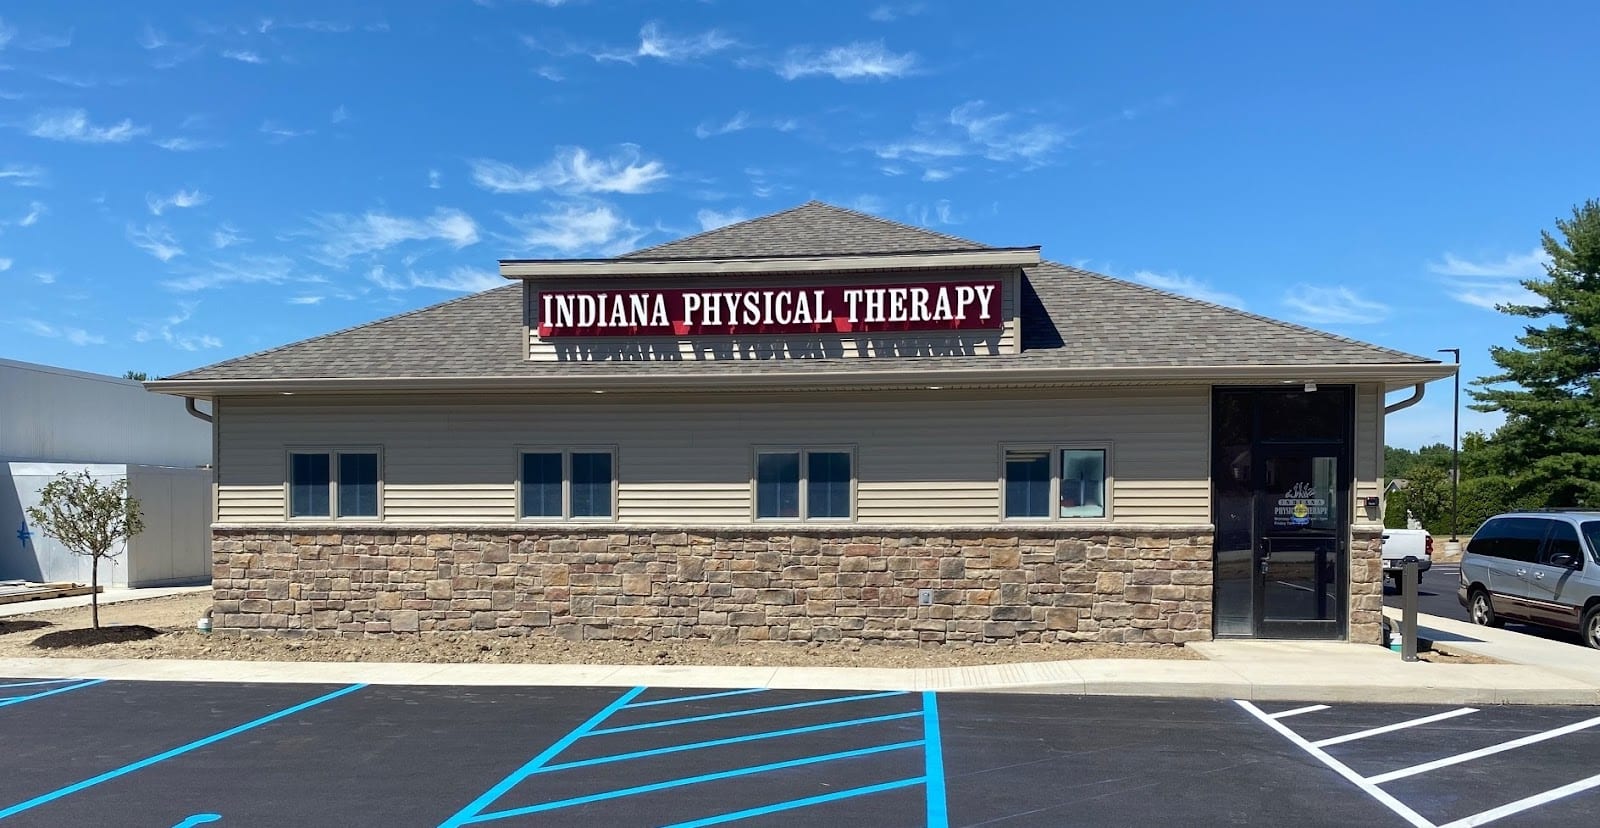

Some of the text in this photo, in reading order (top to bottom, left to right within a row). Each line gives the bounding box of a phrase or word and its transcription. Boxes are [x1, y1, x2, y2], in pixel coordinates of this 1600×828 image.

[542, 285, 996, 328] INDIANA PHYSICAL THERAPY
